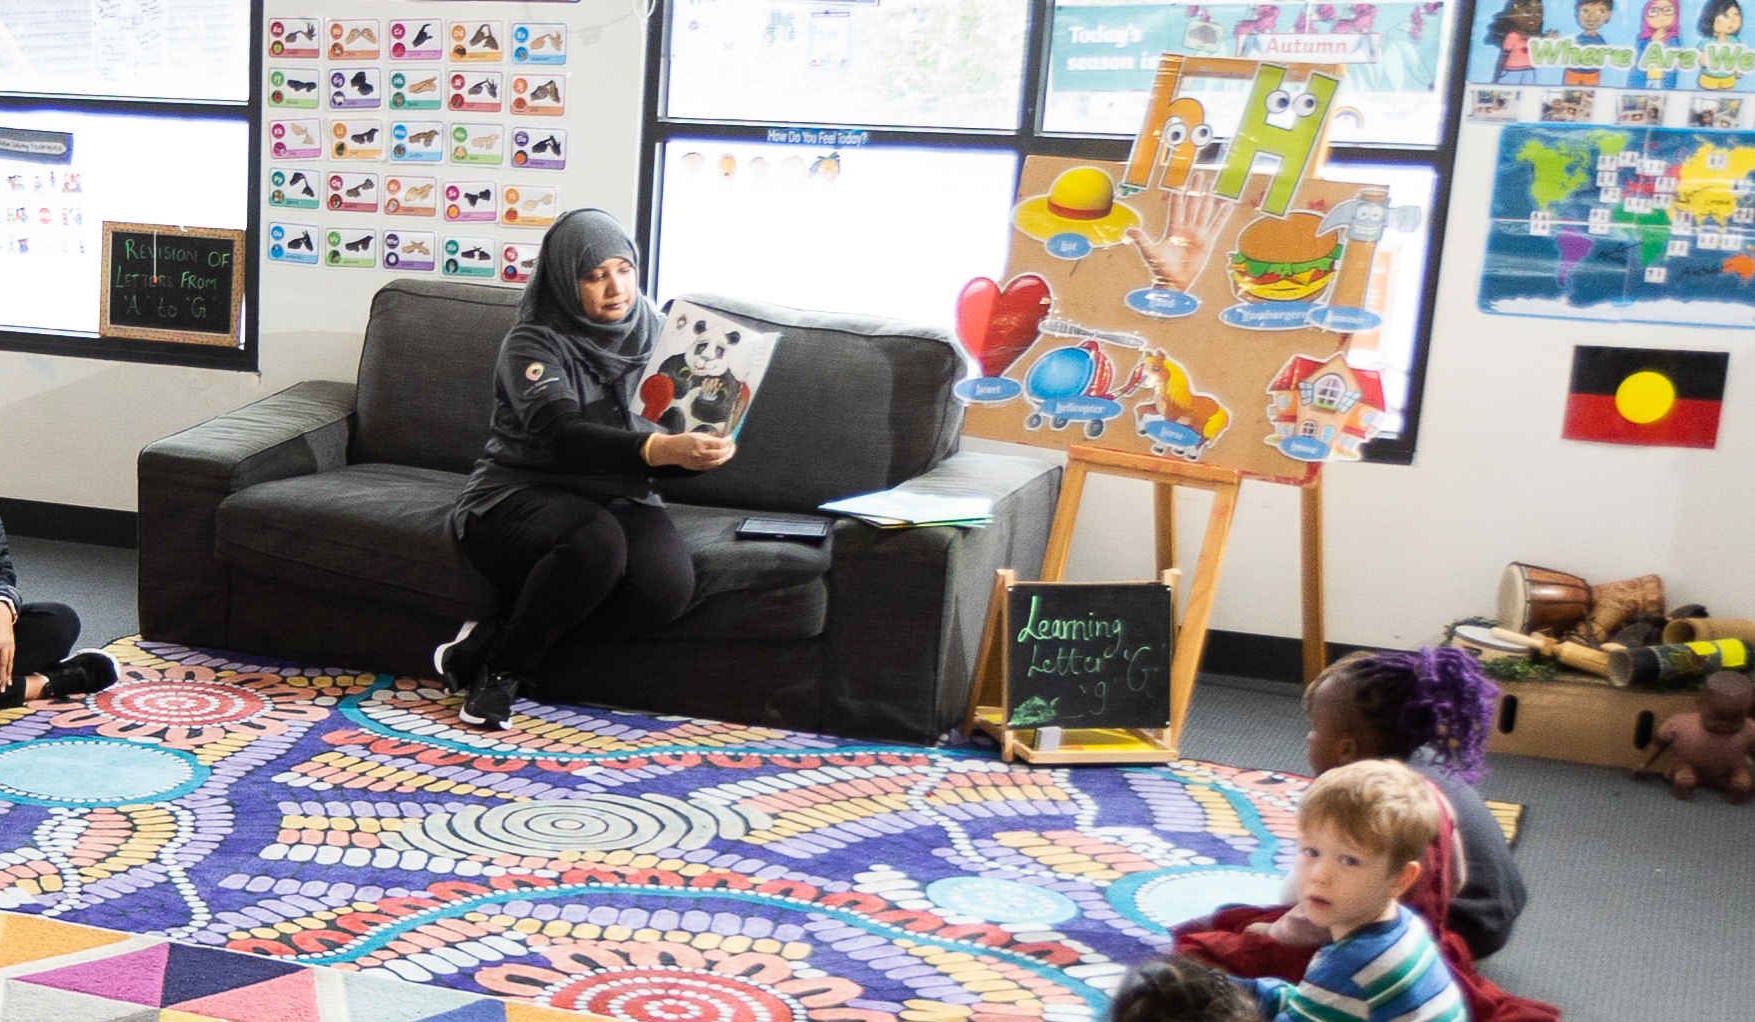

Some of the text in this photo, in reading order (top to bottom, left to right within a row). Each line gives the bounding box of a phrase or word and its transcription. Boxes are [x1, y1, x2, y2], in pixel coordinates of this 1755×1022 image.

[1067, 24, 1143, 49] Today's
[1266, 38, 1347, 54] Autumn
[1529, 38, 1755, 71] Where Are We
[1017, 595, 1125, 659] Learning
[1027, 644, 1105, 678] Letter
